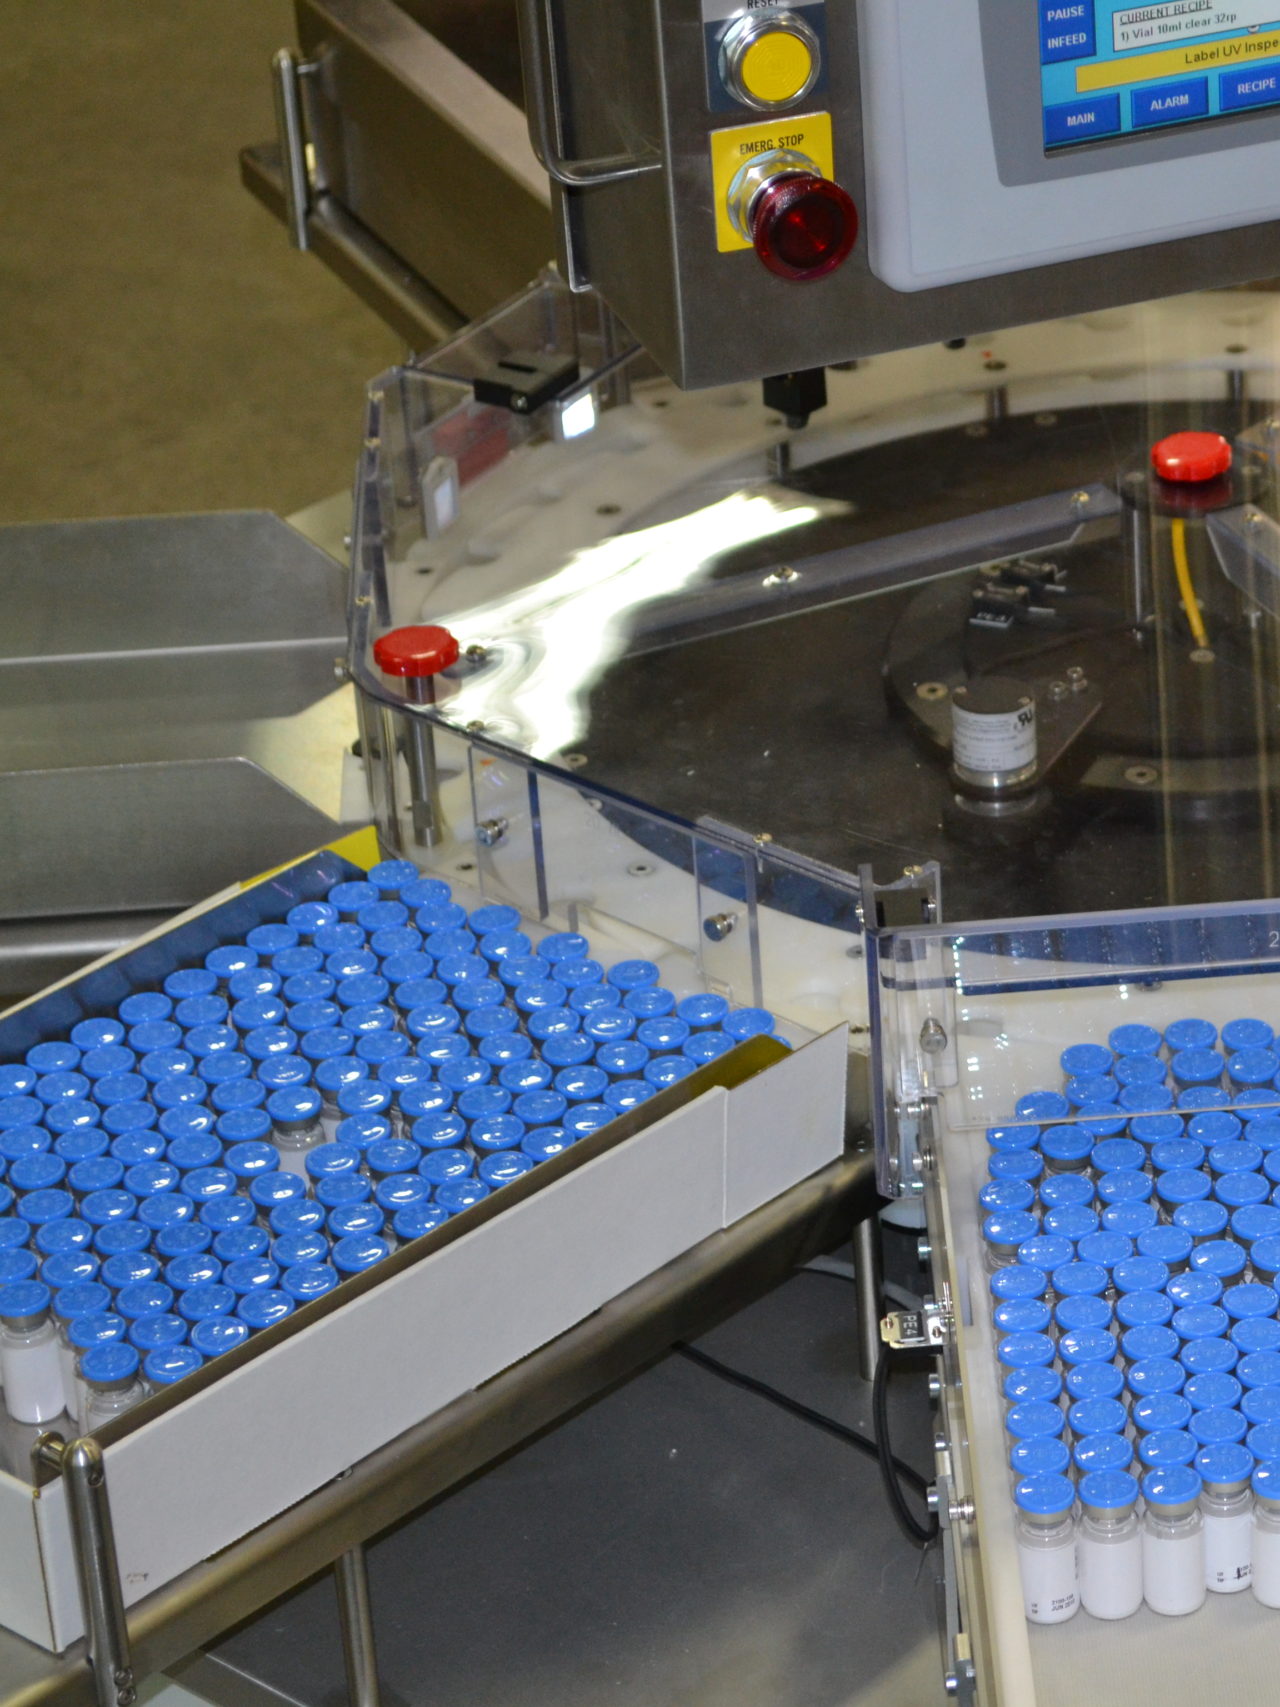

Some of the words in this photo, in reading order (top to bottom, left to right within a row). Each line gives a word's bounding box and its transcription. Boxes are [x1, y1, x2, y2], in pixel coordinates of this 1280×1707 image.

[747, 0, 778, 9] RESET
[1047, 5, 1085, 21] PAUSE
[1120, 6, 1170, 24] CURRENT
[1174, 0, 1212, 15] RECIPE
[1132, 27, 1153, 39] Vial
[1158, 22, 1182, 34] 10ml
[1185, 18, 1211, 29] clear
[1047, 32, 1087, 49] INFEED
[1185, 46, 1219, 64] Label
[1223, 44, 1242, 57] UV
[1238, 78, 1276, 94] RECIPE
[1150, 94, 1189, 111] ALARM
[1067, 112, 1095, 126] MAIN
[740, 139, 776, 155] EMERG.
[778, 133, 804, 149] STOP
[903, 1315, 918, 1336] PE4
